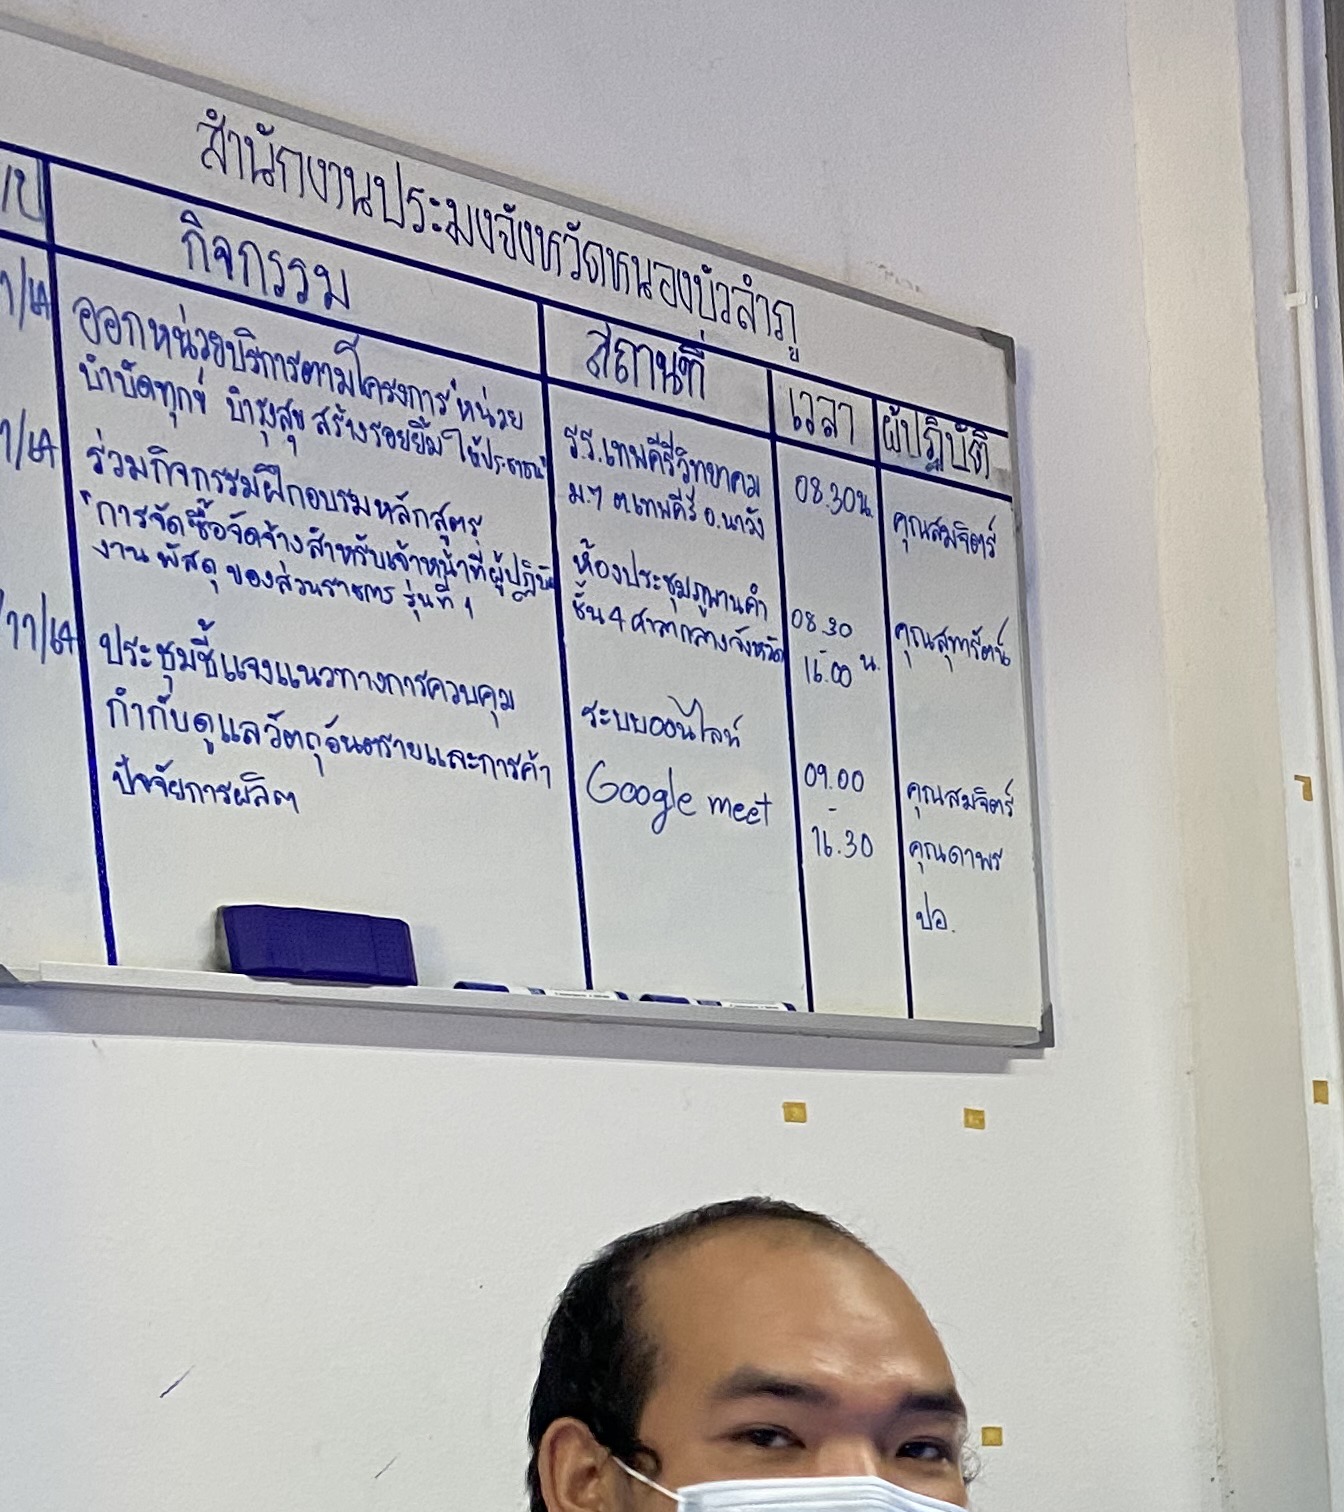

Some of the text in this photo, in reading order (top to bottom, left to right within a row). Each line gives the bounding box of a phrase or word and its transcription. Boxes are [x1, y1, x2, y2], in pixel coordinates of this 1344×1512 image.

[179, 209, 351, 310] กิจกรรม
[196, 107, 800, 362] สำนักงานประมงจังหวัดหนองบัวลำภู
[586, 321, 706, 401] สถานที่
[789, 387, 854, 446] เวลา
[585, 759, 773, 835] Google meet
